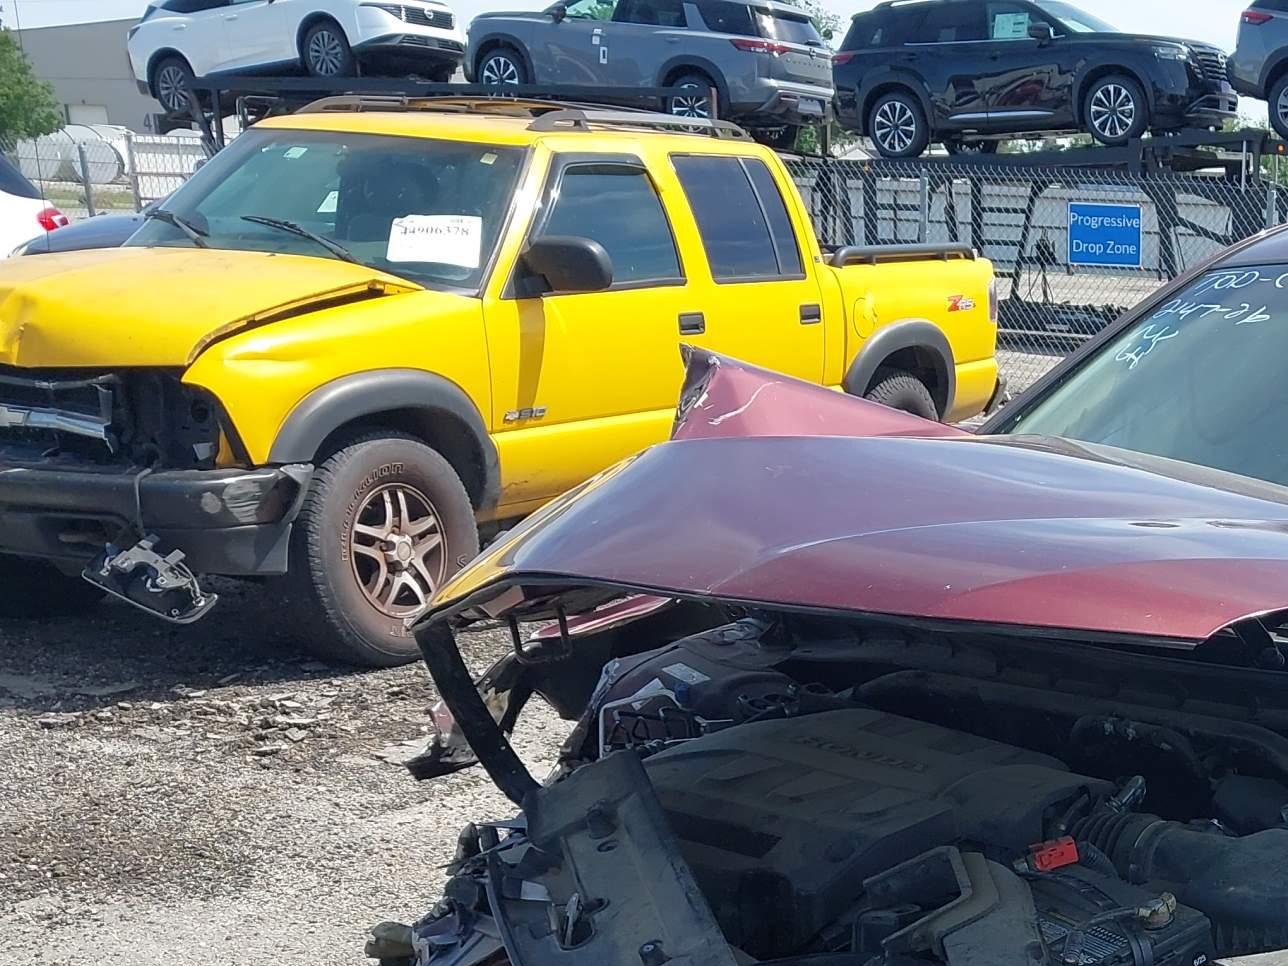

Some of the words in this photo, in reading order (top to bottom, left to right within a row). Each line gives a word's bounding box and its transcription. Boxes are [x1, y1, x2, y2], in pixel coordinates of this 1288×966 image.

[1070, 212, 1140, 229] Progressive
[1072, 239, 1104, 256] Drop
[1106, 240, 1137, 255] Zone
